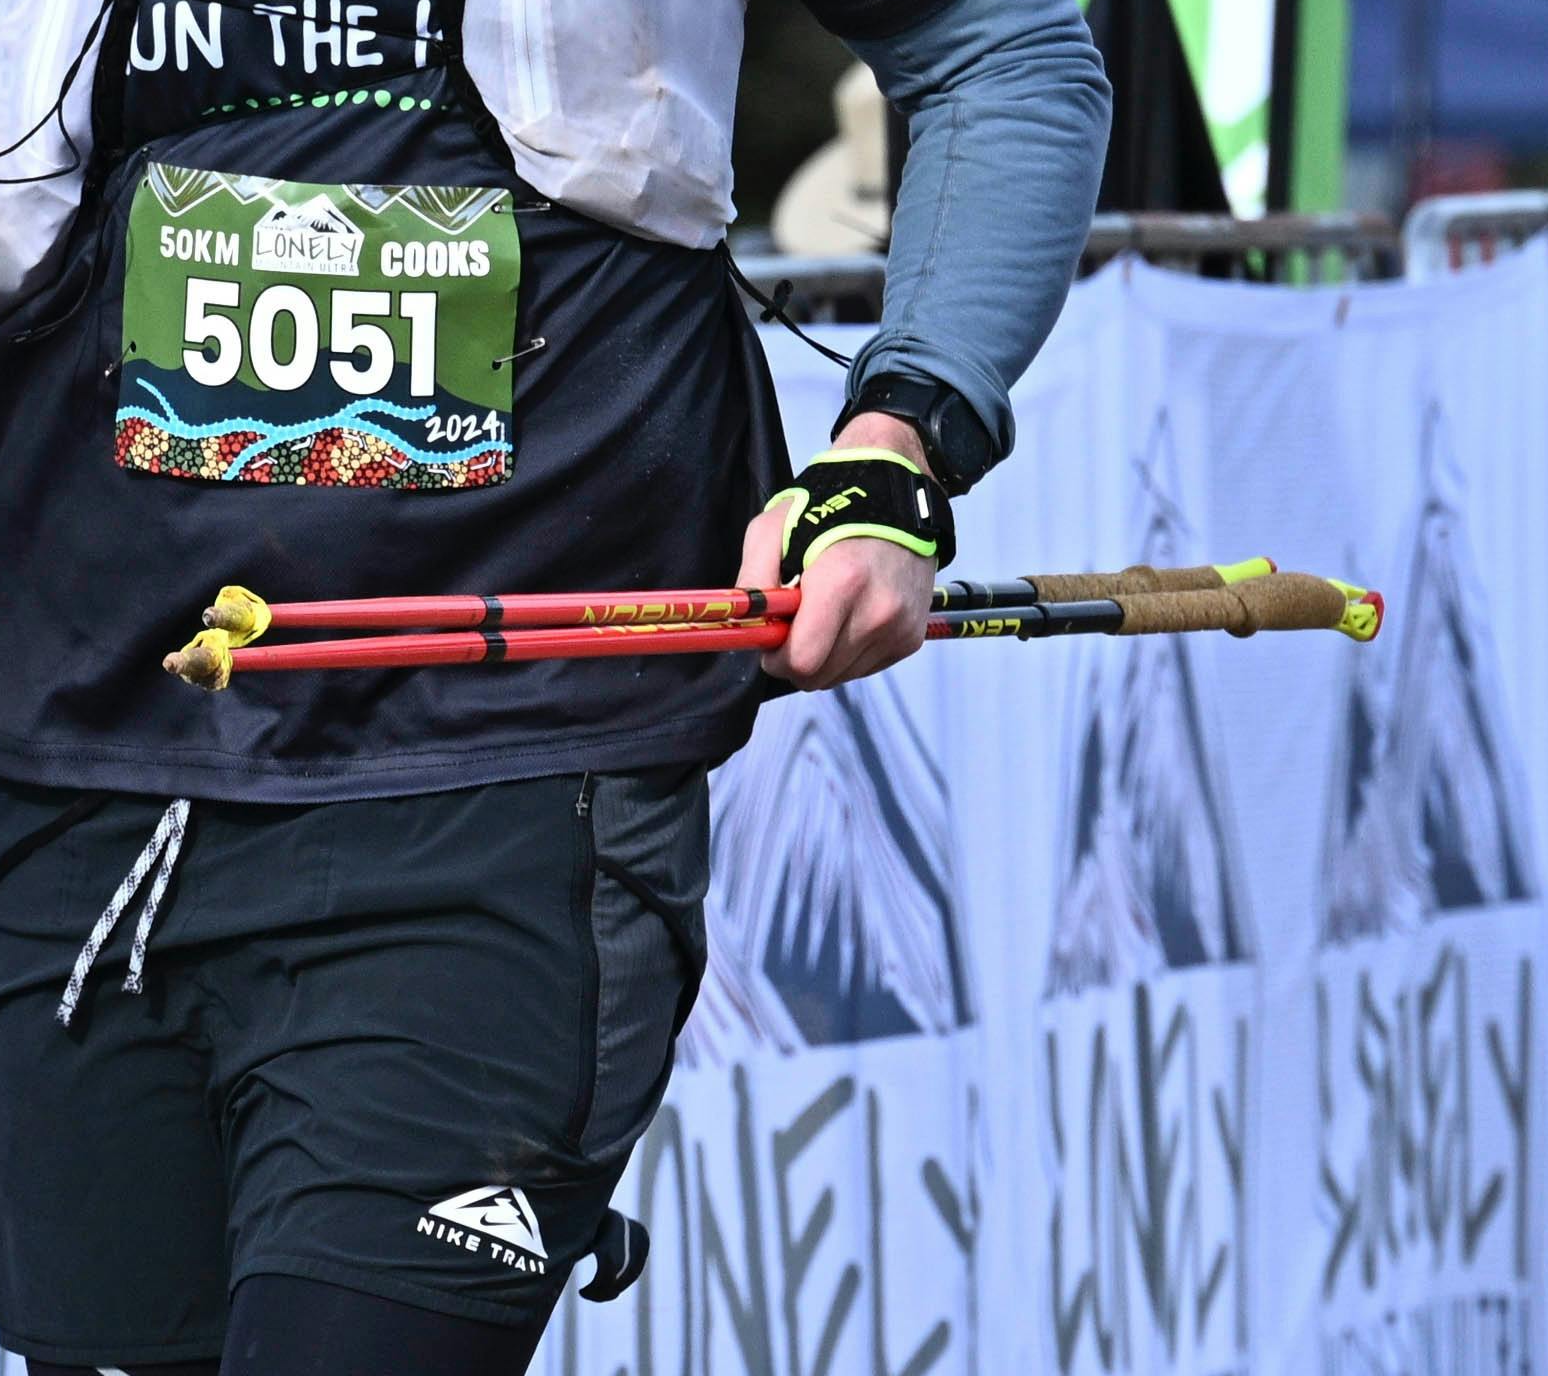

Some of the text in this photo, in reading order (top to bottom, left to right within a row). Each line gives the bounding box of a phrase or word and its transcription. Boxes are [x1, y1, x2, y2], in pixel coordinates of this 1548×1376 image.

[126, 1, 223, 75] UN
[160, 226, 491, 278] 50KM COOKS
[256, 231, 357, 264] LONELY
[182, 275, 439, 397] 5051
[425, 410, 501, 443] 2024
[804, 486, 868, 525] LEKI
[960, 617, 1022, 638] LEKI
[416, 1216, 481, 1253] NIKE
